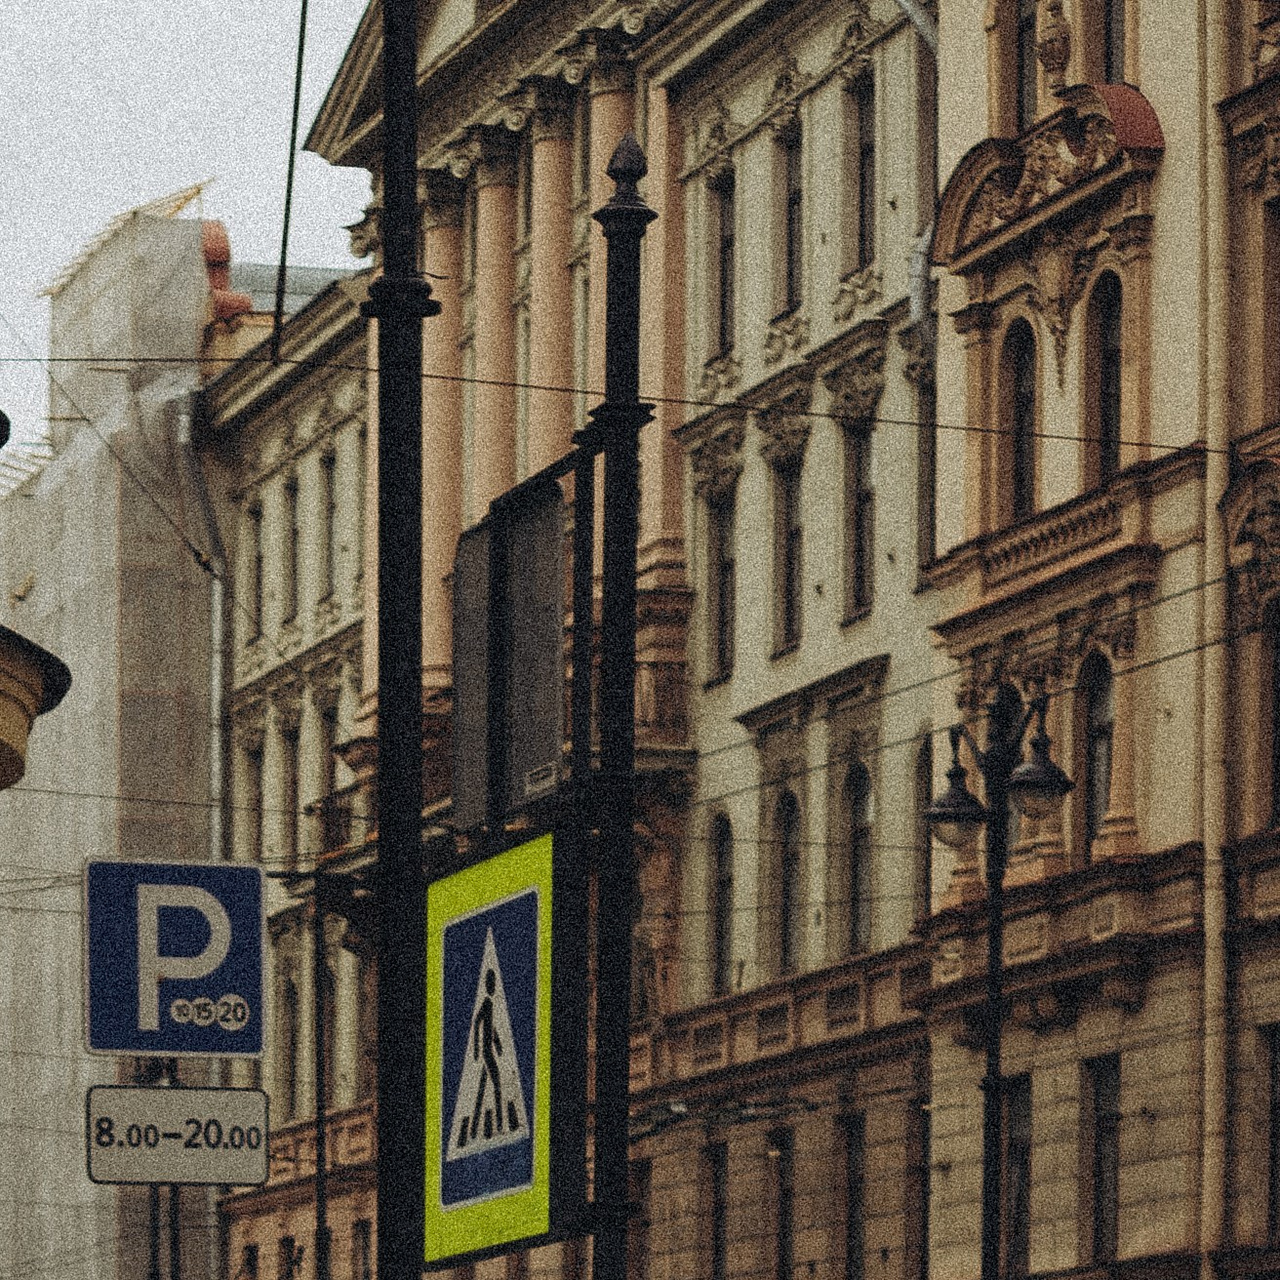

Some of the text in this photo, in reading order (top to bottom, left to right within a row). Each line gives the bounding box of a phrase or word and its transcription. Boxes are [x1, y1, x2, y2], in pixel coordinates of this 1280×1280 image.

[137, 885, 231, 1031] P
[194, 1001, 213, 1020] 15
[219, 1001, 247, 1023] 20
